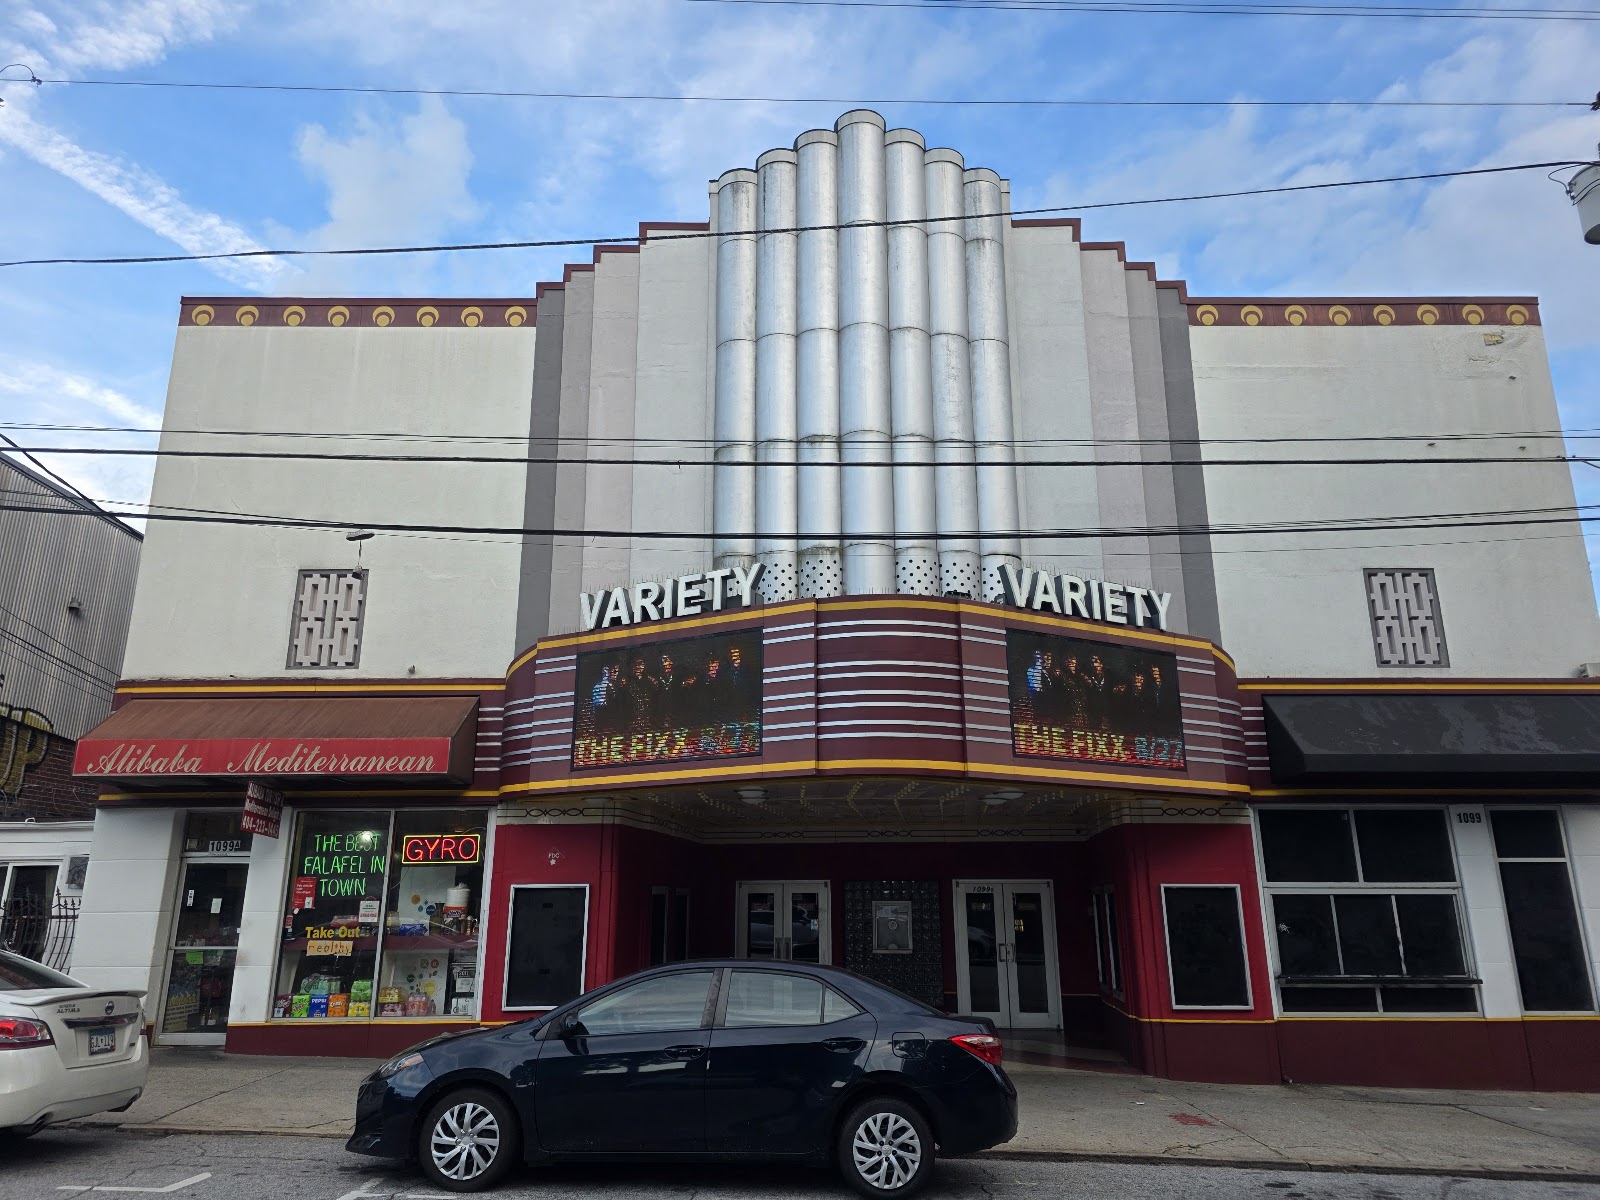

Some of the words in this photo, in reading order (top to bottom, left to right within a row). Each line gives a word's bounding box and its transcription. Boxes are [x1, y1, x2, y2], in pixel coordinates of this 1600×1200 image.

[580, 562, 766, 631] VARIETY
[1000, 562, 1172, 632] VARIETY
[575, 736, 624, 763] THE
[631, 727, 688, 759] FIXX
[1014, 723, 1066, 755] THE
[1072, 730, 1125, 758] FIXX
[87, 743, 203, 774] Alibaba
[227, 742, 435, 772] Mediterranean
[1457, 812, 1481, 823] 1099
[315, 834, 342, 852] THE
[345, 833, 381, 852] BEST
[406, 837, 476, 860] GYRO
[303, 855, 366, 875] FALAFEL
[370, 855, 385, 874] IN
[320, 877, 366, 897] TOWN
[305, 926, 335, 938] Take
[338, 926, 360, 938] Out
[56, 1006, 81, 1014] ALTIMA
